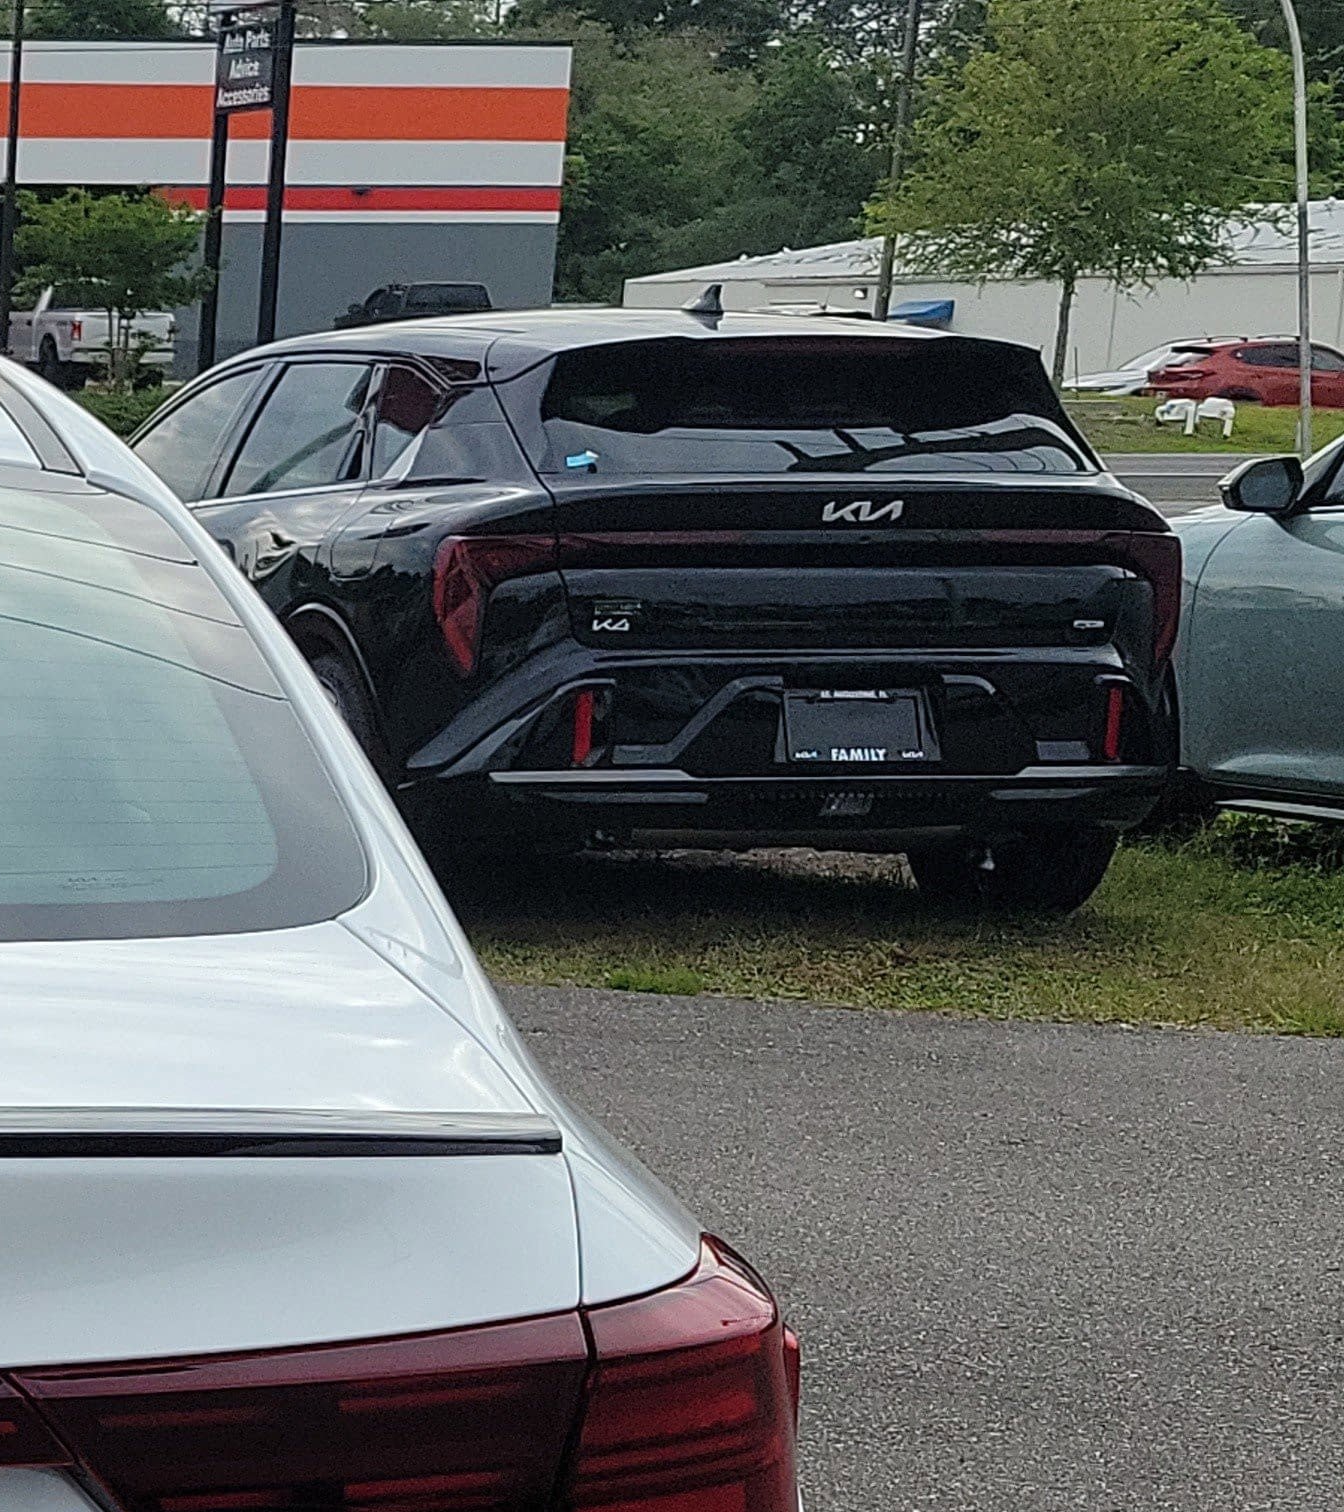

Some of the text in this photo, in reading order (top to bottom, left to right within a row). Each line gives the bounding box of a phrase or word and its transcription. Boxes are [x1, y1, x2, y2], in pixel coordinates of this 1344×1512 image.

[246, 29, 271, 49] Parts
[229, 58, 260, 79] Advice
[216, 83, 272, 107] Accessories
[822, 500, 904, 522] KIA
[592, 618, 630, 631] K4
[831, 748, 886, 761] FAMILY
